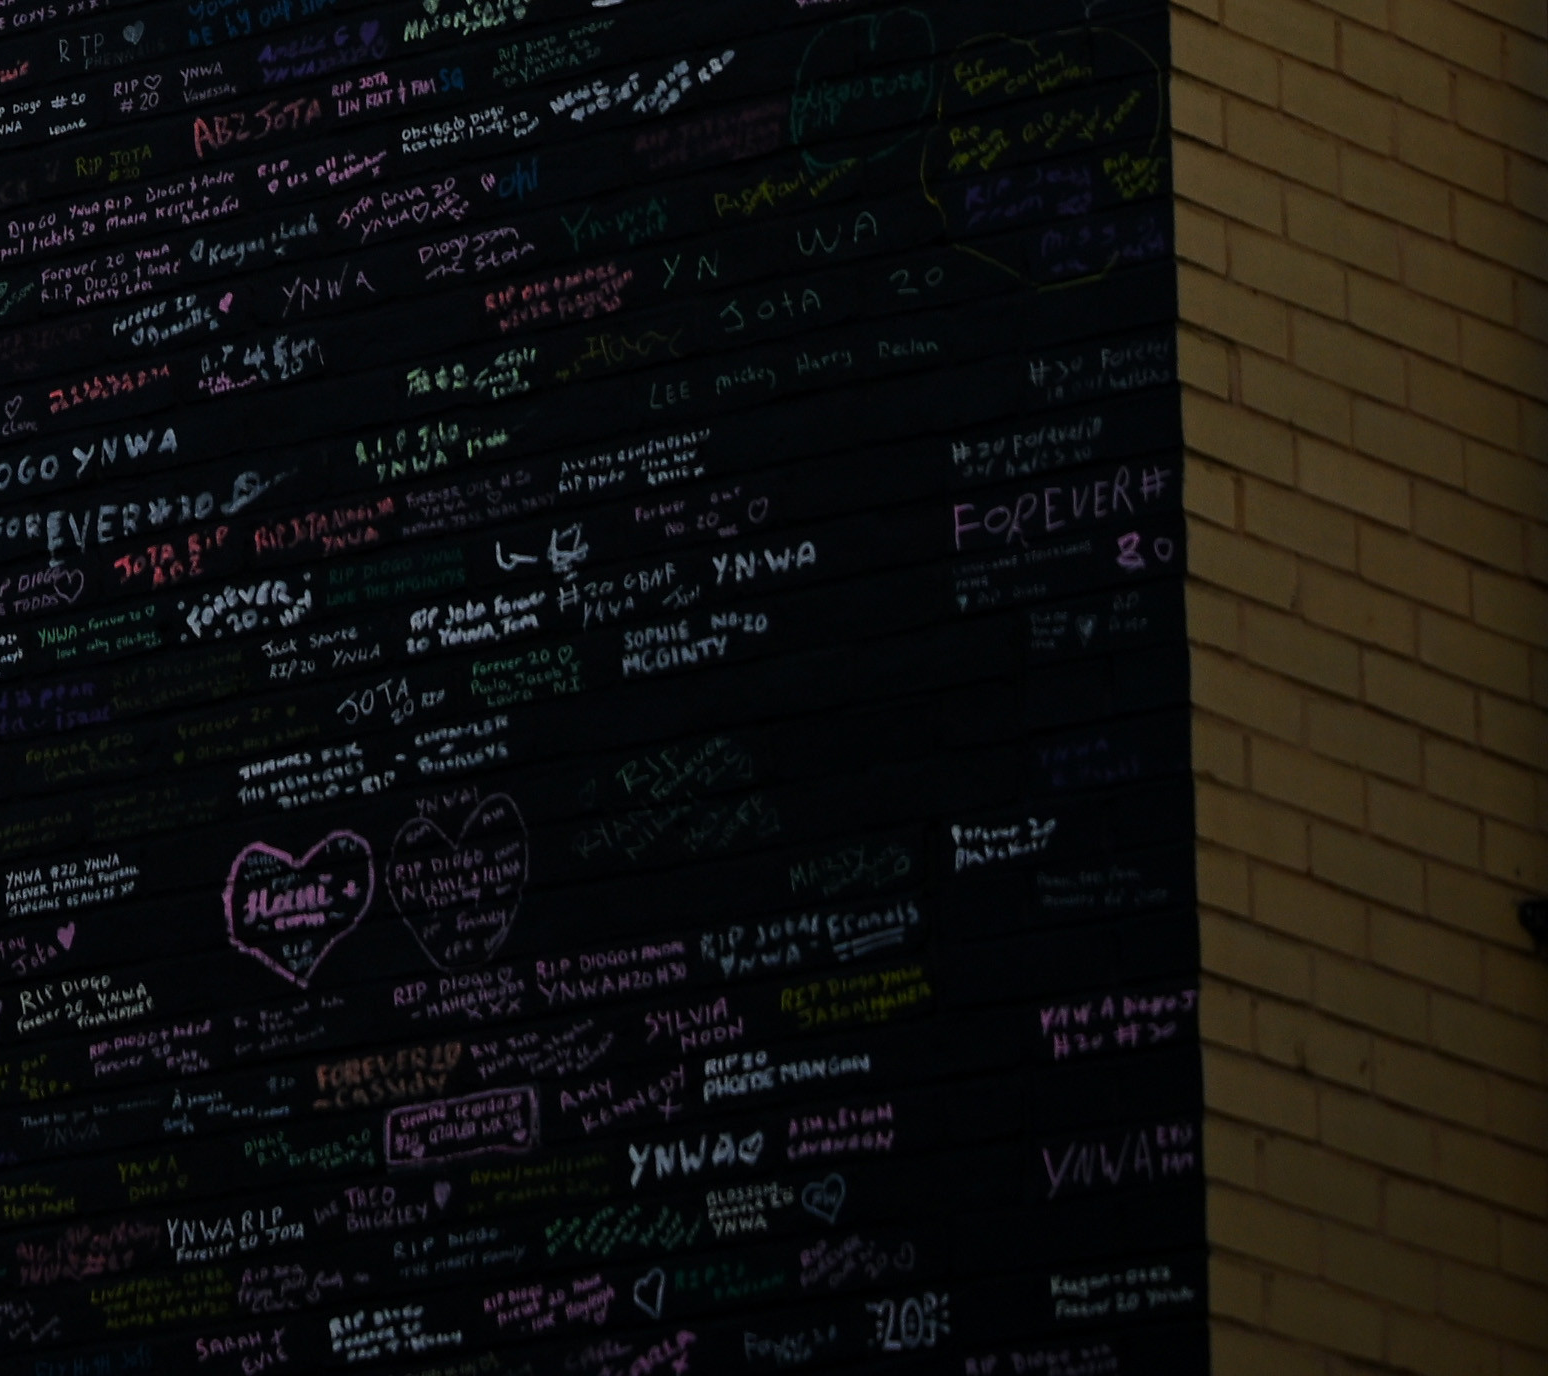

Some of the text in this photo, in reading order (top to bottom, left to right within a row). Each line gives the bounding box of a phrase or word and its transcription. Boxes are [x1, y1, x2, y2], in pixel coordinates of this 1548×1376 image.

[282, 265, 375, 316] YNWA
[954, 469, 1134, 553] FOREVER
[629, 1135, 735, 1186] YNWA
[167, 1218, 234, 1247] YNWA
